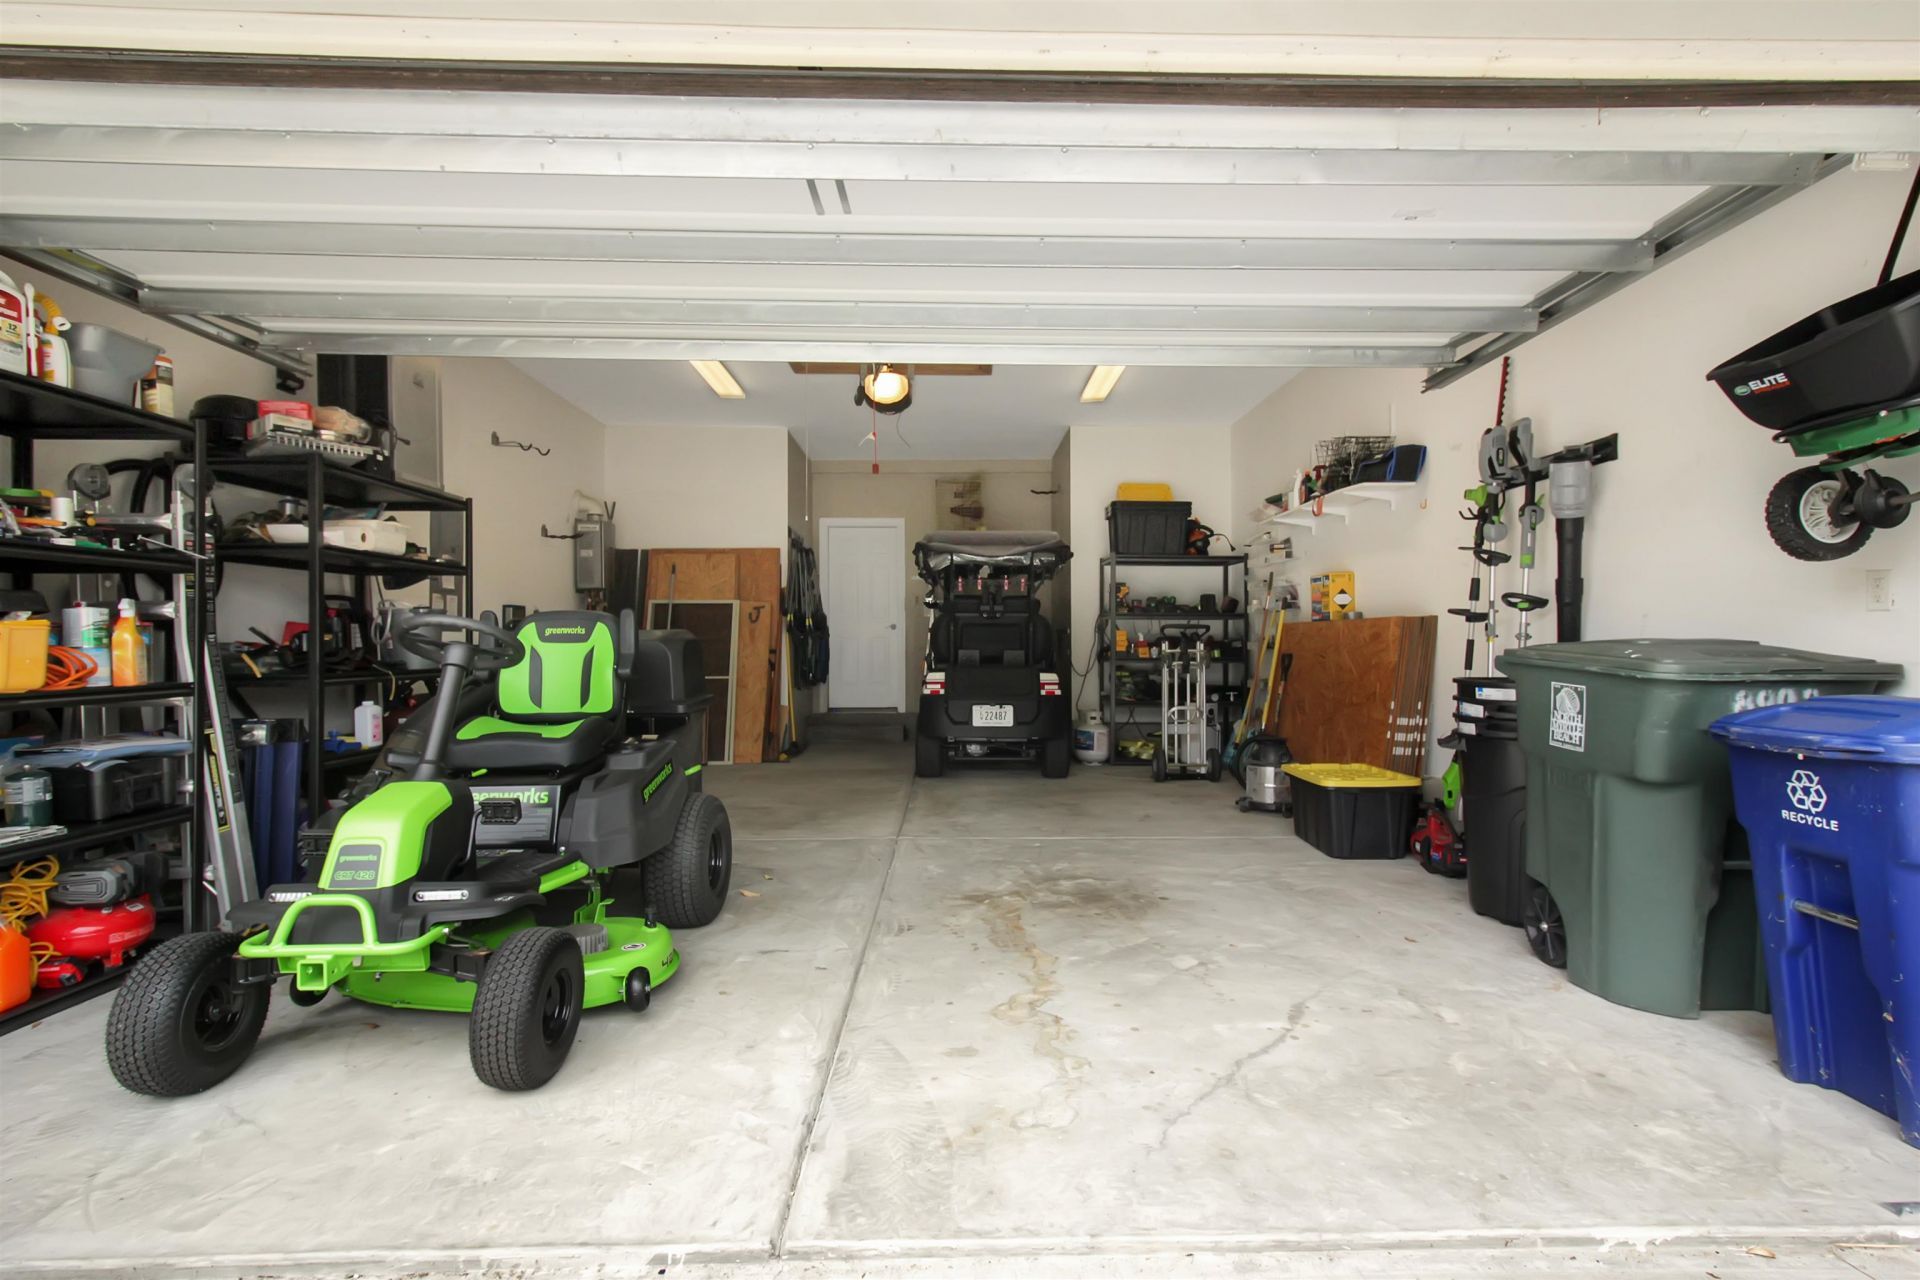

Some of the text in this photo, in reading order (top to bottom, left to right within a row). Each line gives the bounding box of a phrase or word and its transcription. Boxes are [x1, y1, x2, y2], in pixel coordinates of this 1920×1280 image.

[1747, 372, 1788, 391] ELITE
[544, 625, 586, 637] greenworks
[1553, 710, 1582, 725] NORTH
[1551, 719, 1583, 736] MYRTLE
[1553, 729, 1580, 745] BEACH
[643, 762, 673, 803] greenworks
[1781, 809, 1839, 832] RECYCLE
